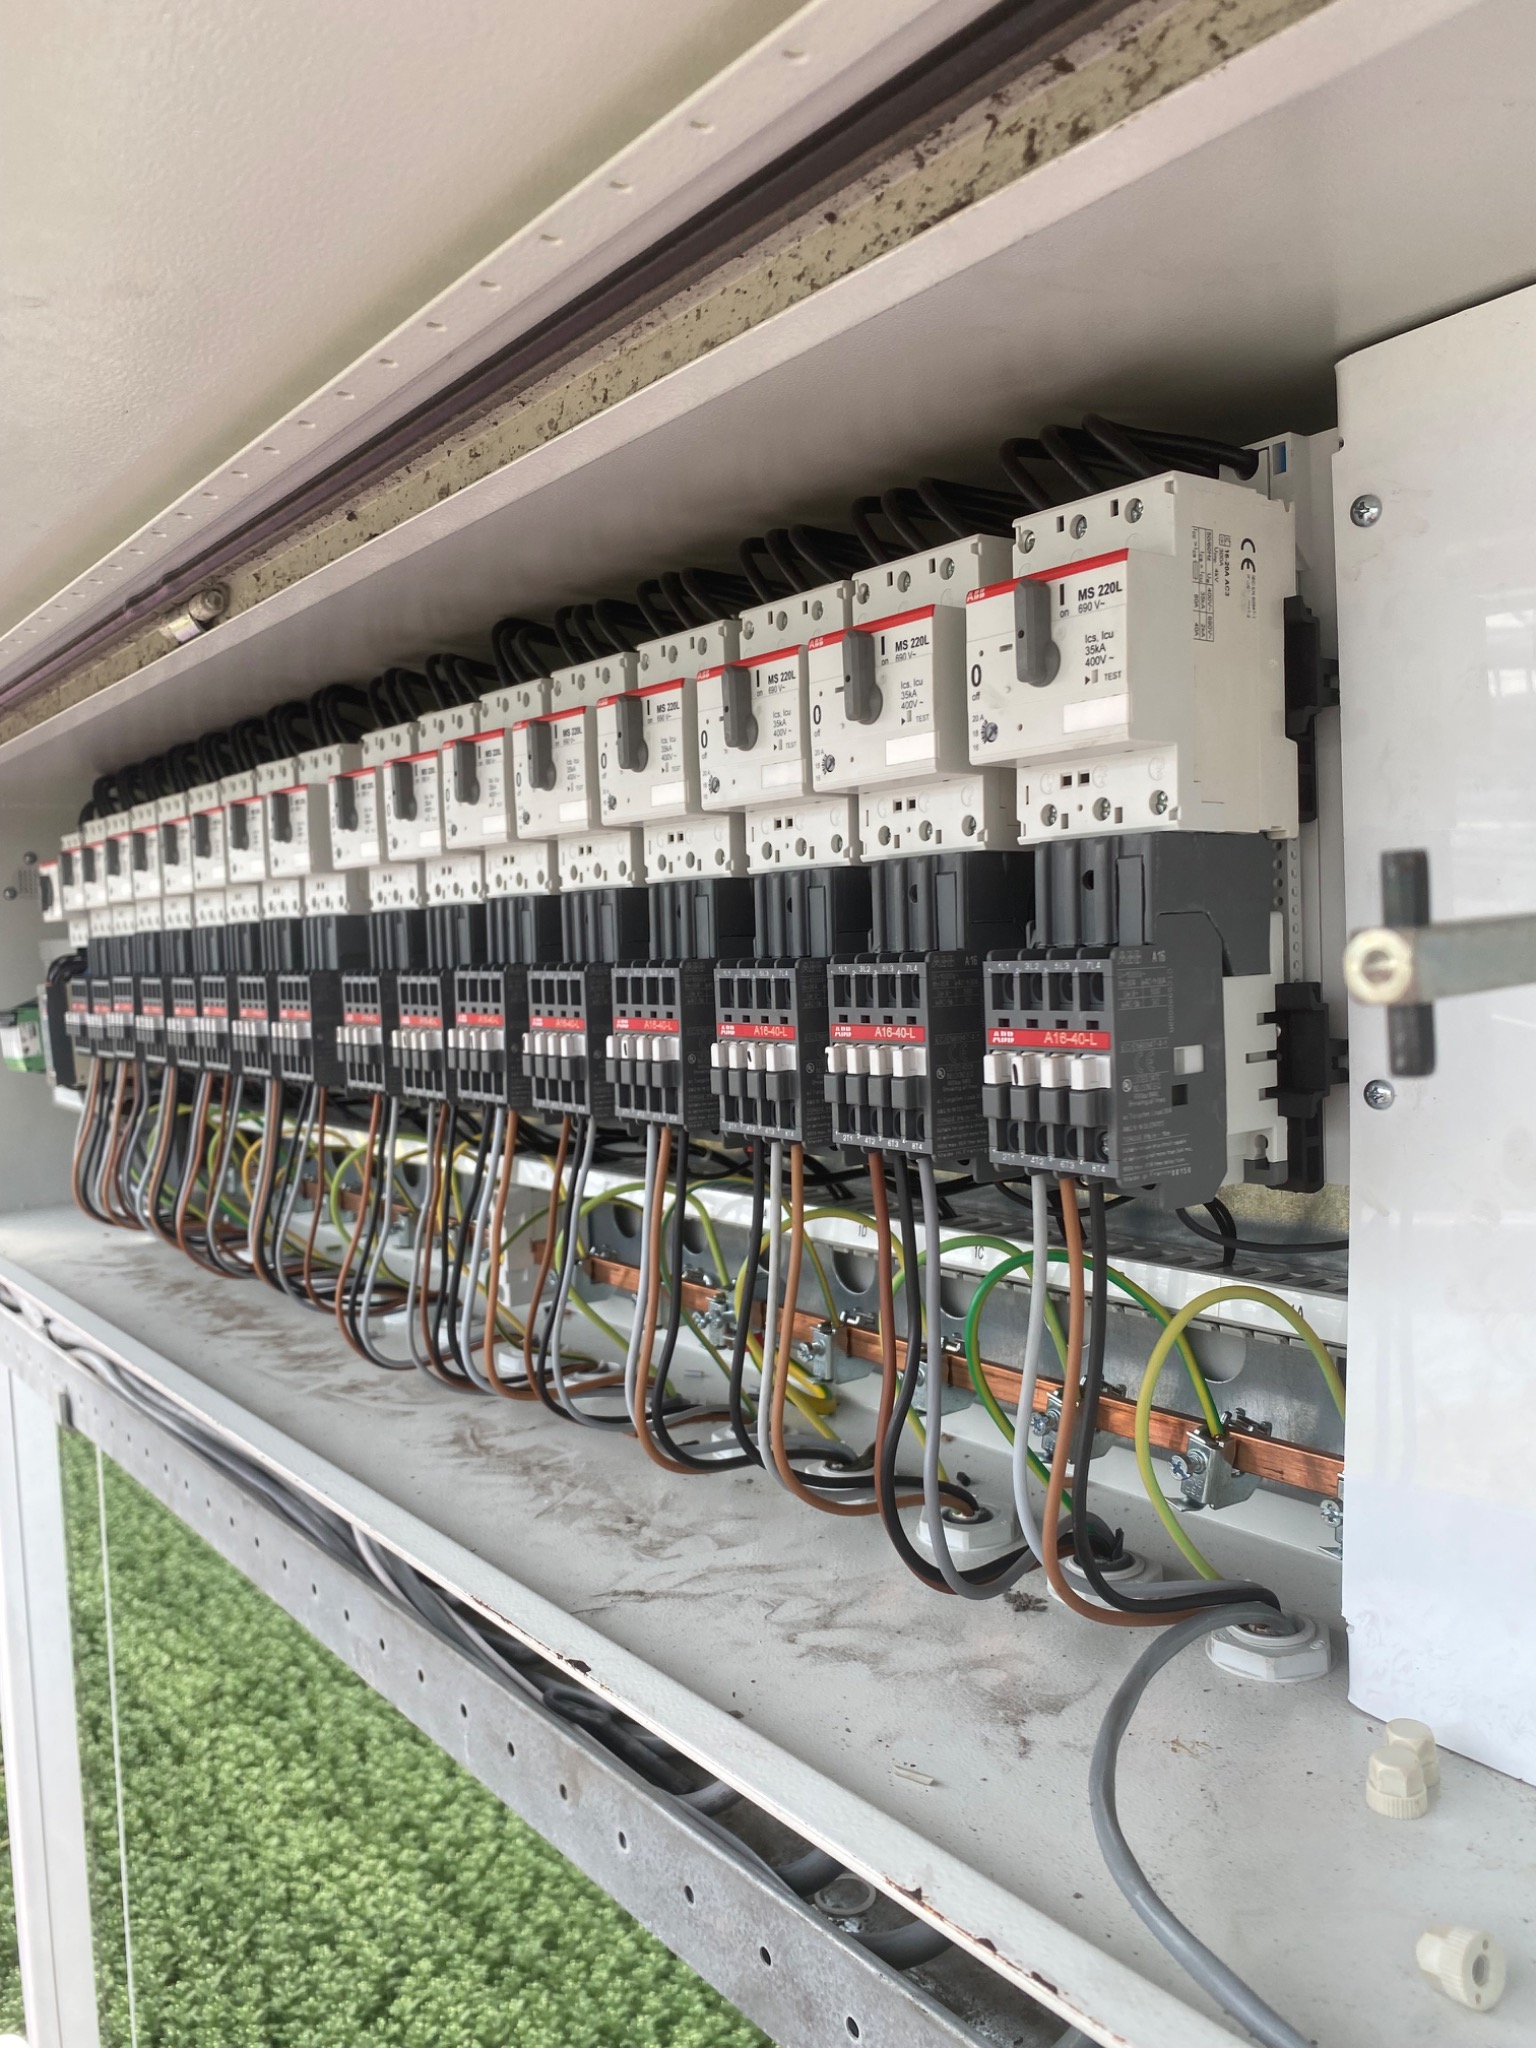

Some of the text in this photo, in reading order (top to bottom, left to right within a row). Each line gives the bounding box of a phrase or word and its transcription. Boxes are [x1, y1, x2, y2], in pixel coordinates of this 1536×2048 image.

[966, 588, 985, 602] ABB
[1078, 581, 1122, 601] MS 220L
[1060, 609, 1069, 618] on
[1078, 602, 1092, 614] 690
[1101, 631, 1114, 640] Icu
[808, 637, 824, 649] ABB
[895, 635, 930, 653] MS 220L
[1085, 643, 1106, 656] 35kA
[881, 658, 889, 666] on
[895, 653, 907, 663] 690
[1085, 655, 1107, 667] 400V
[768, 670, 796, 685] MS 220L
[1104, 671, 1122, 681] TEST
[901, 689, 917, 700] 35kA
[972, 691, 981, 701] off
[901, 700, 918, 710] 400V
[916, 713, 930, 722] TEST
[965, 955, 978, 966] A16
[1024, 962, 1039, 970] 3L2
[859, 965, 871, 973] 3L2
[906, 964, 918, 972] 7L4
[754, 1025, 788, 1037] A16-40-L
[834, 1026, 916, 1039] ABB A16-40-L
[992, 1031, 1014, 1043] ABB
[974, 1245, 984, 1260] 1C
